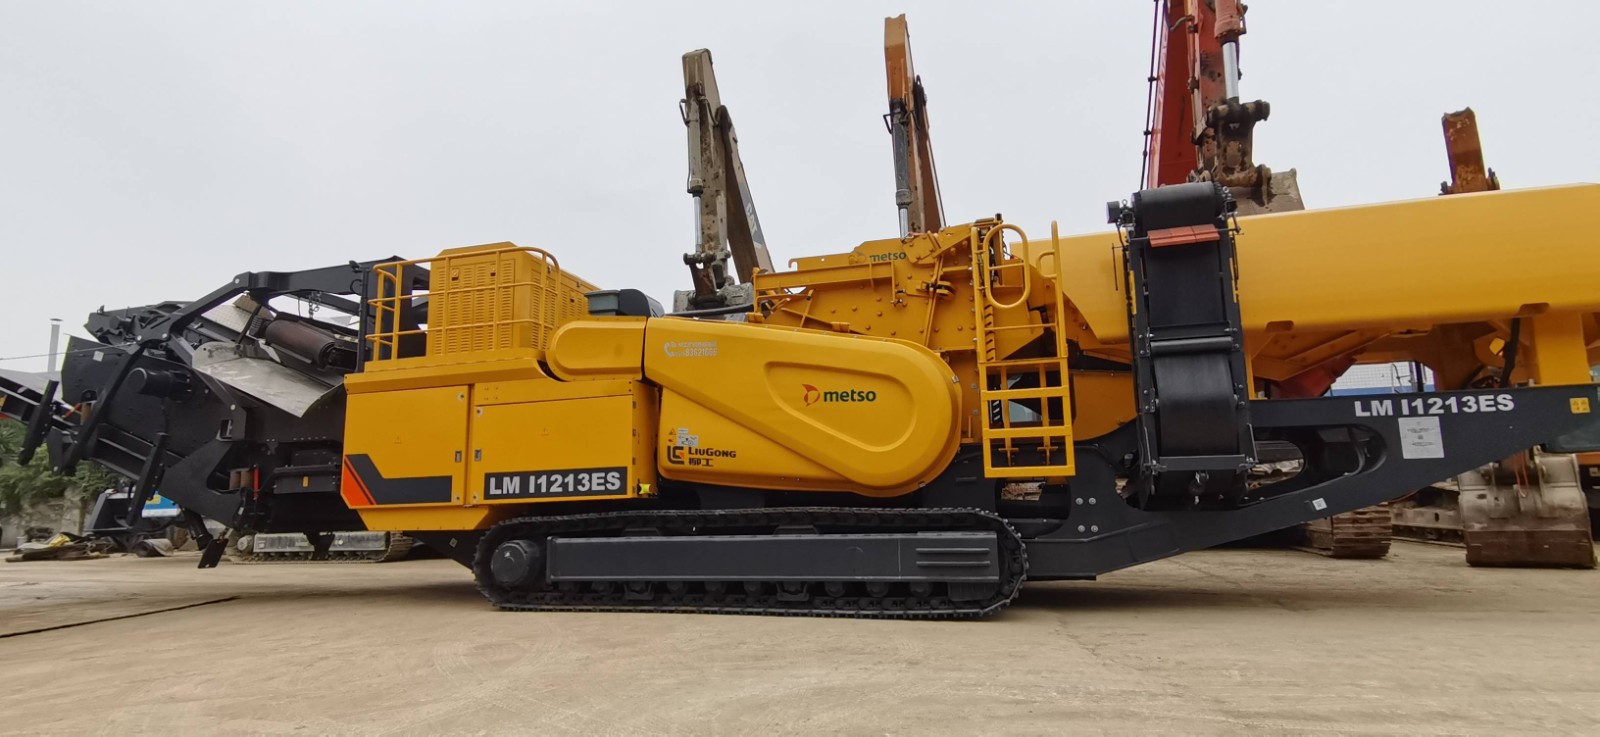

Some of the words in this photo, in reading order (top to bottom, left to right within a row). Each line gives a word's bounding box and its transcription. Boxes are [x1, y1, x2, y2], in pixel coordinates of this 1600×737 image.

[869, 252, 907, 262] metso
[823, 389, 877, 402] metso
[1354, 400, 1394, 417] LM
[1401, 394, 1515, 416] I1213ES
[489, 476, 520, 495] LM
[528, 471, 621, 494] I1213ES
